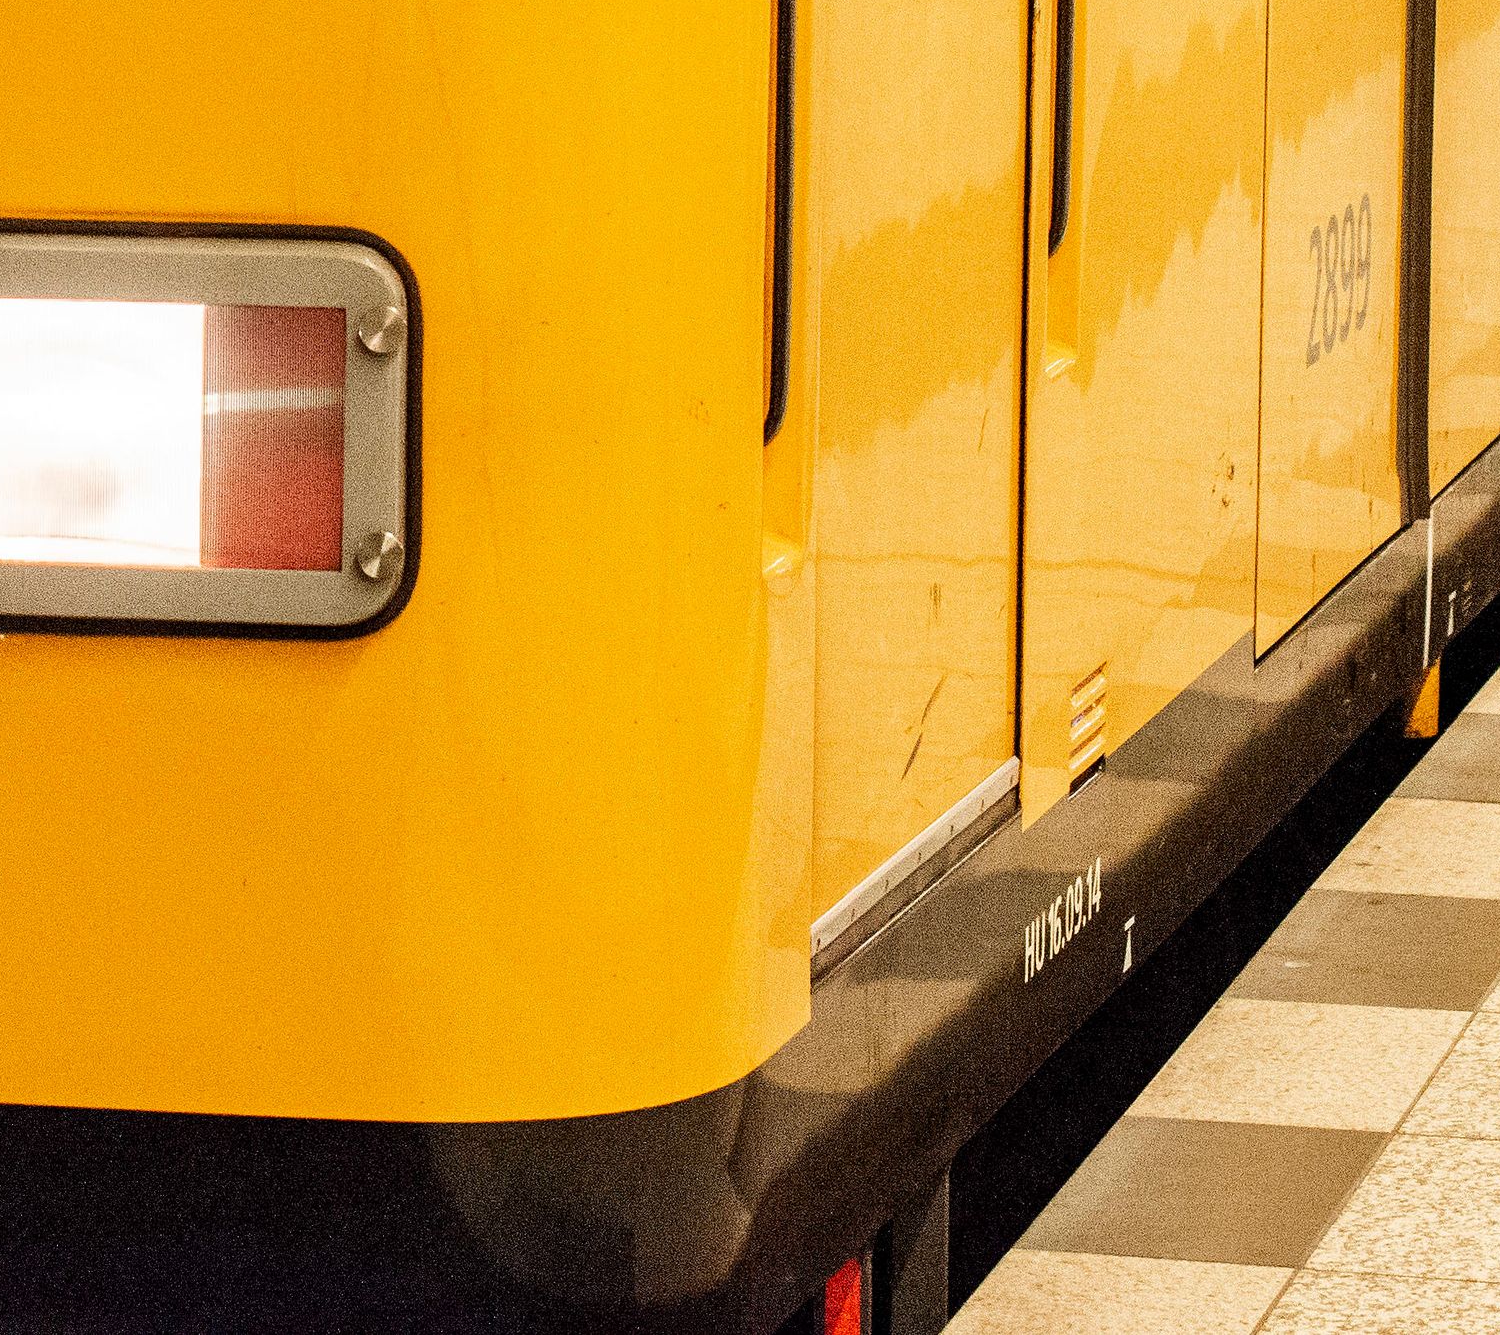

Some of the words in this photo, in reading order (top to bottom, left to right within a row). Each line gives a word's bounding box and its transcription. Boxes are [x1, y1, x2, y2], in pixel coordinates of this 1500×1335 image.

[1306, 193, 1372, 369] 2899
[1023, 910, 1047, 983] HU
[1047, 856, 1102, 961] 16.09.14
